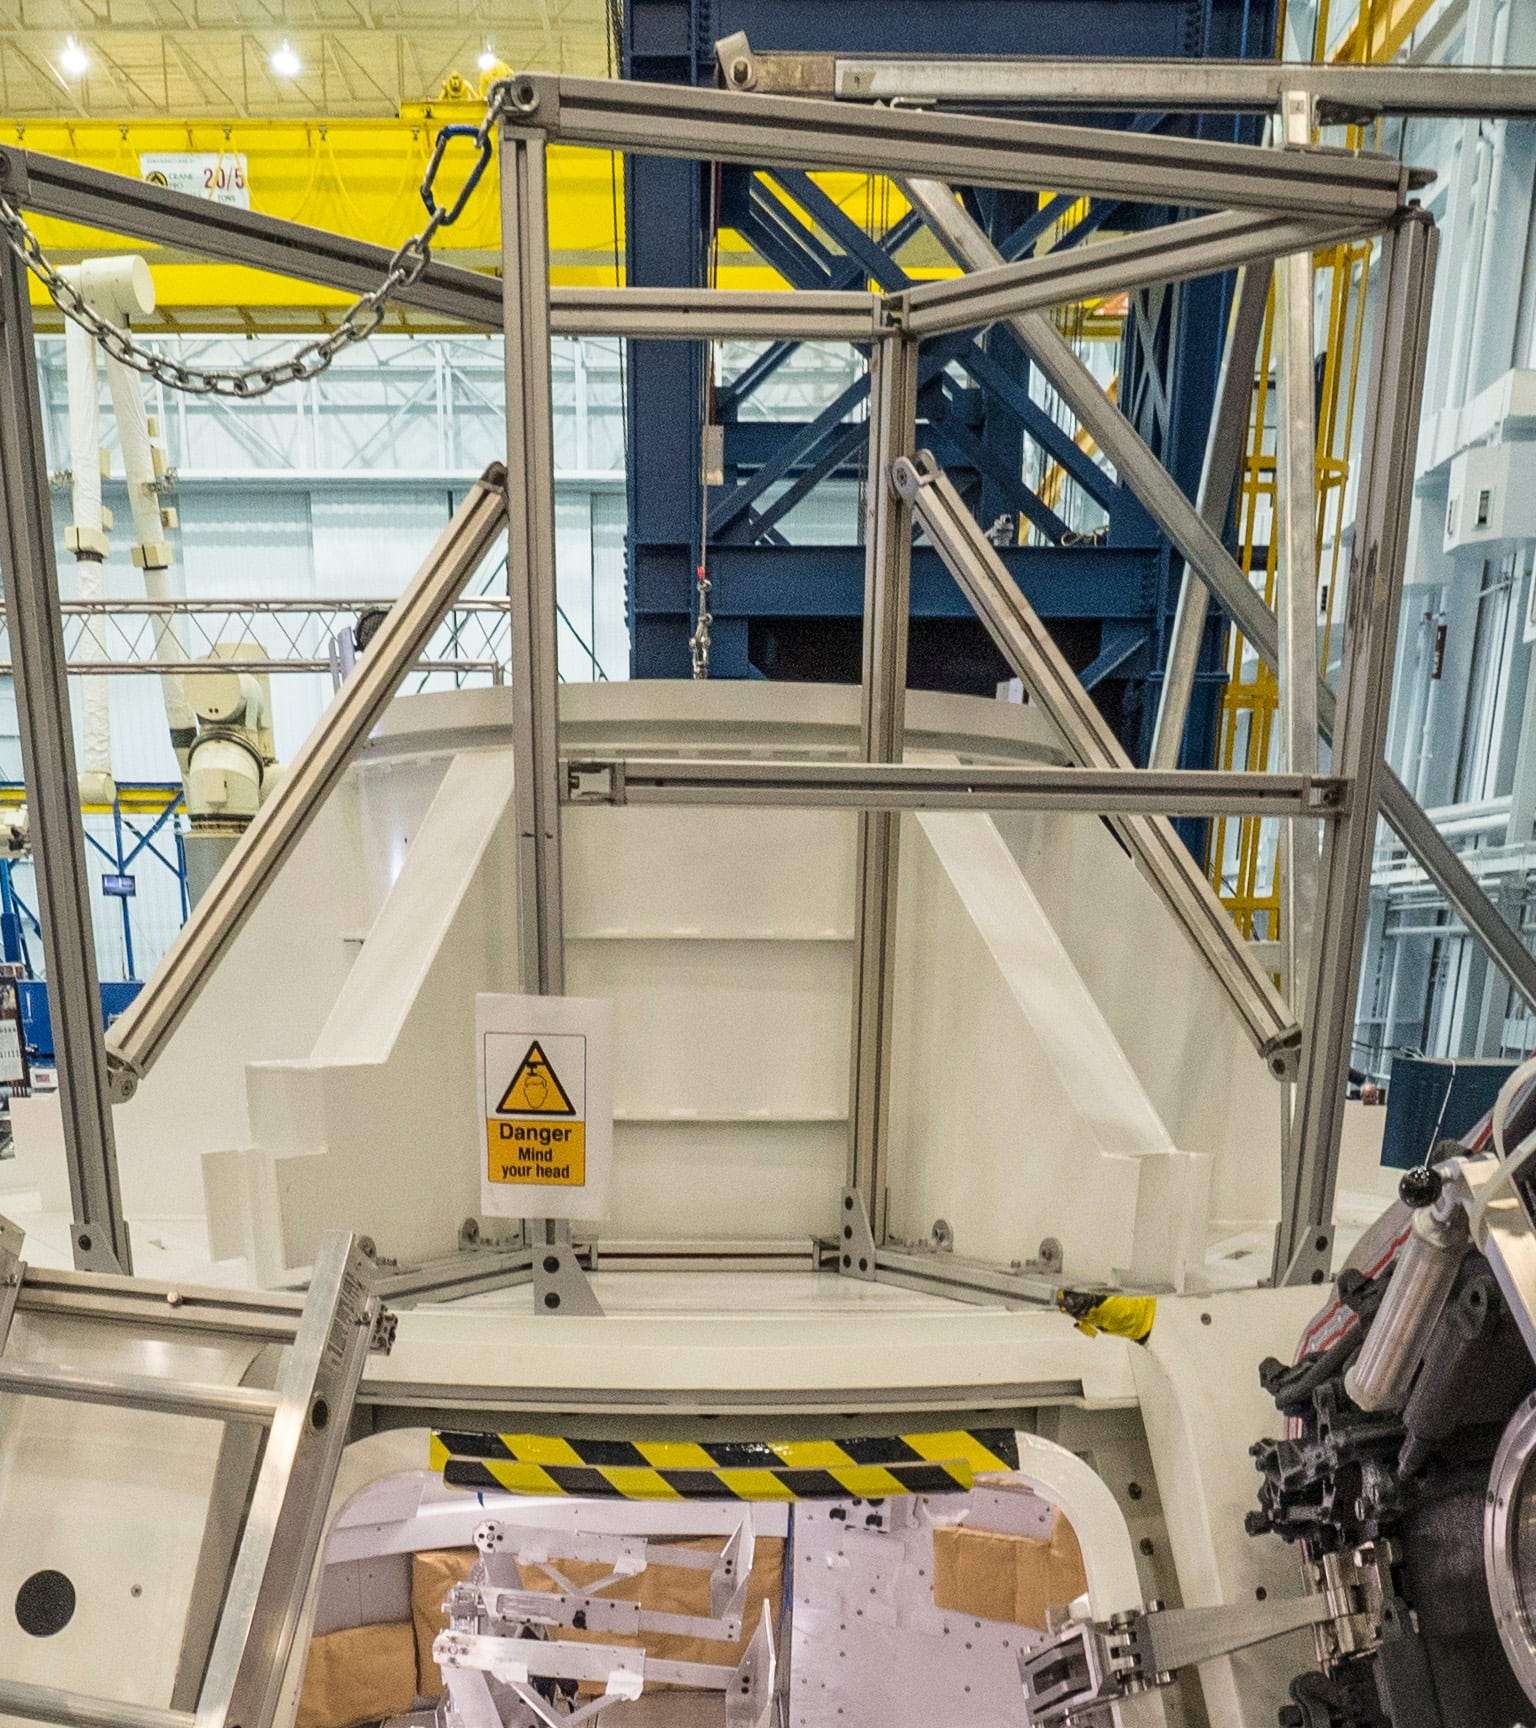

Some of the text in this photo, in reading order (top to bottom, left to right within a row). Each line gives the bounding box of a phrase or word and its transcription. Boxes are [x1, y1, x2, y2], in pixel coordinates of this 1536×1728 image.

[203, 167, 245, 190] 20/5
[499, 1122, 572, 1146] Danger
[518, 1146, 553, 1162] Mind
[501, 1163, 570, 1179] your head
